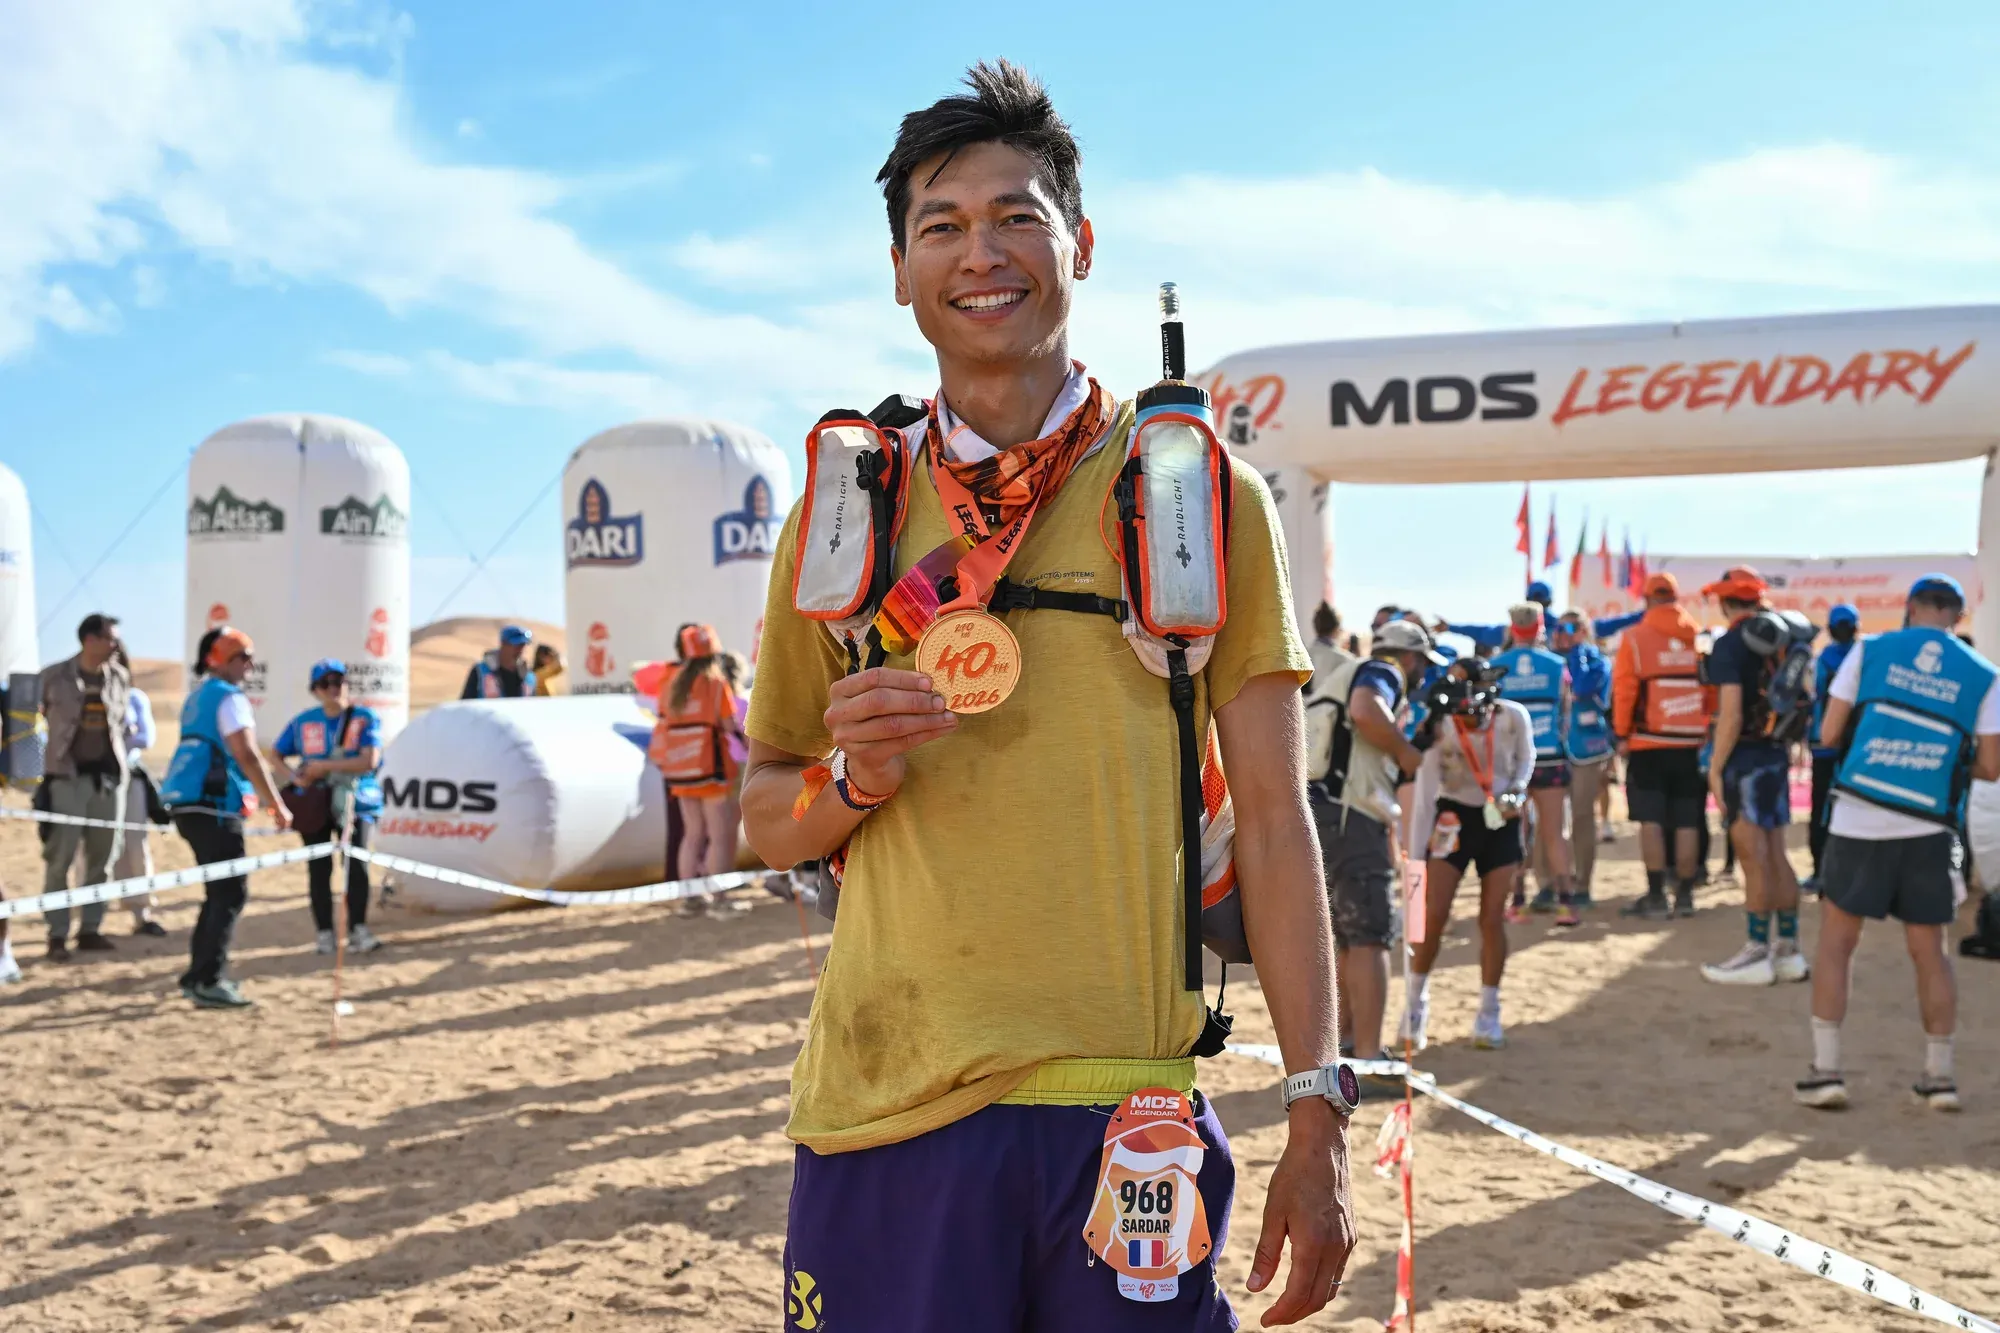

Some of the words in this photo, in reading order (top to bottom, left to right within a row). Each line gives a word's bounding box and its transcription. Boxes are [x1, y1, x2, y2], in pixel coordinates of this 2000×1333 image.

[1162, 329, 1170, 364] RAIDLIGHT
[1330, 371, 1540, 428] MDS
[1551, 338, 1979, 429] LEGENDARY
[835, 474, 848, 530] RAIDLIGHT
[1173, 478, 1186, 540] RAIDLIGHT
[567, 525, 637, 559] DARI
[935, 641, 997, 688] 40
[950, 689, 1000, 710] 2026
[382, 775, 498, 813] MDS
[1130, 1095, 1180, 1109] MDS
[1130, 1109, 1179, 1117] LEGENDARY
[1120, 1180, 1173, 1214] 968
[1121, 1218, 1170, 1233] SARDAR
